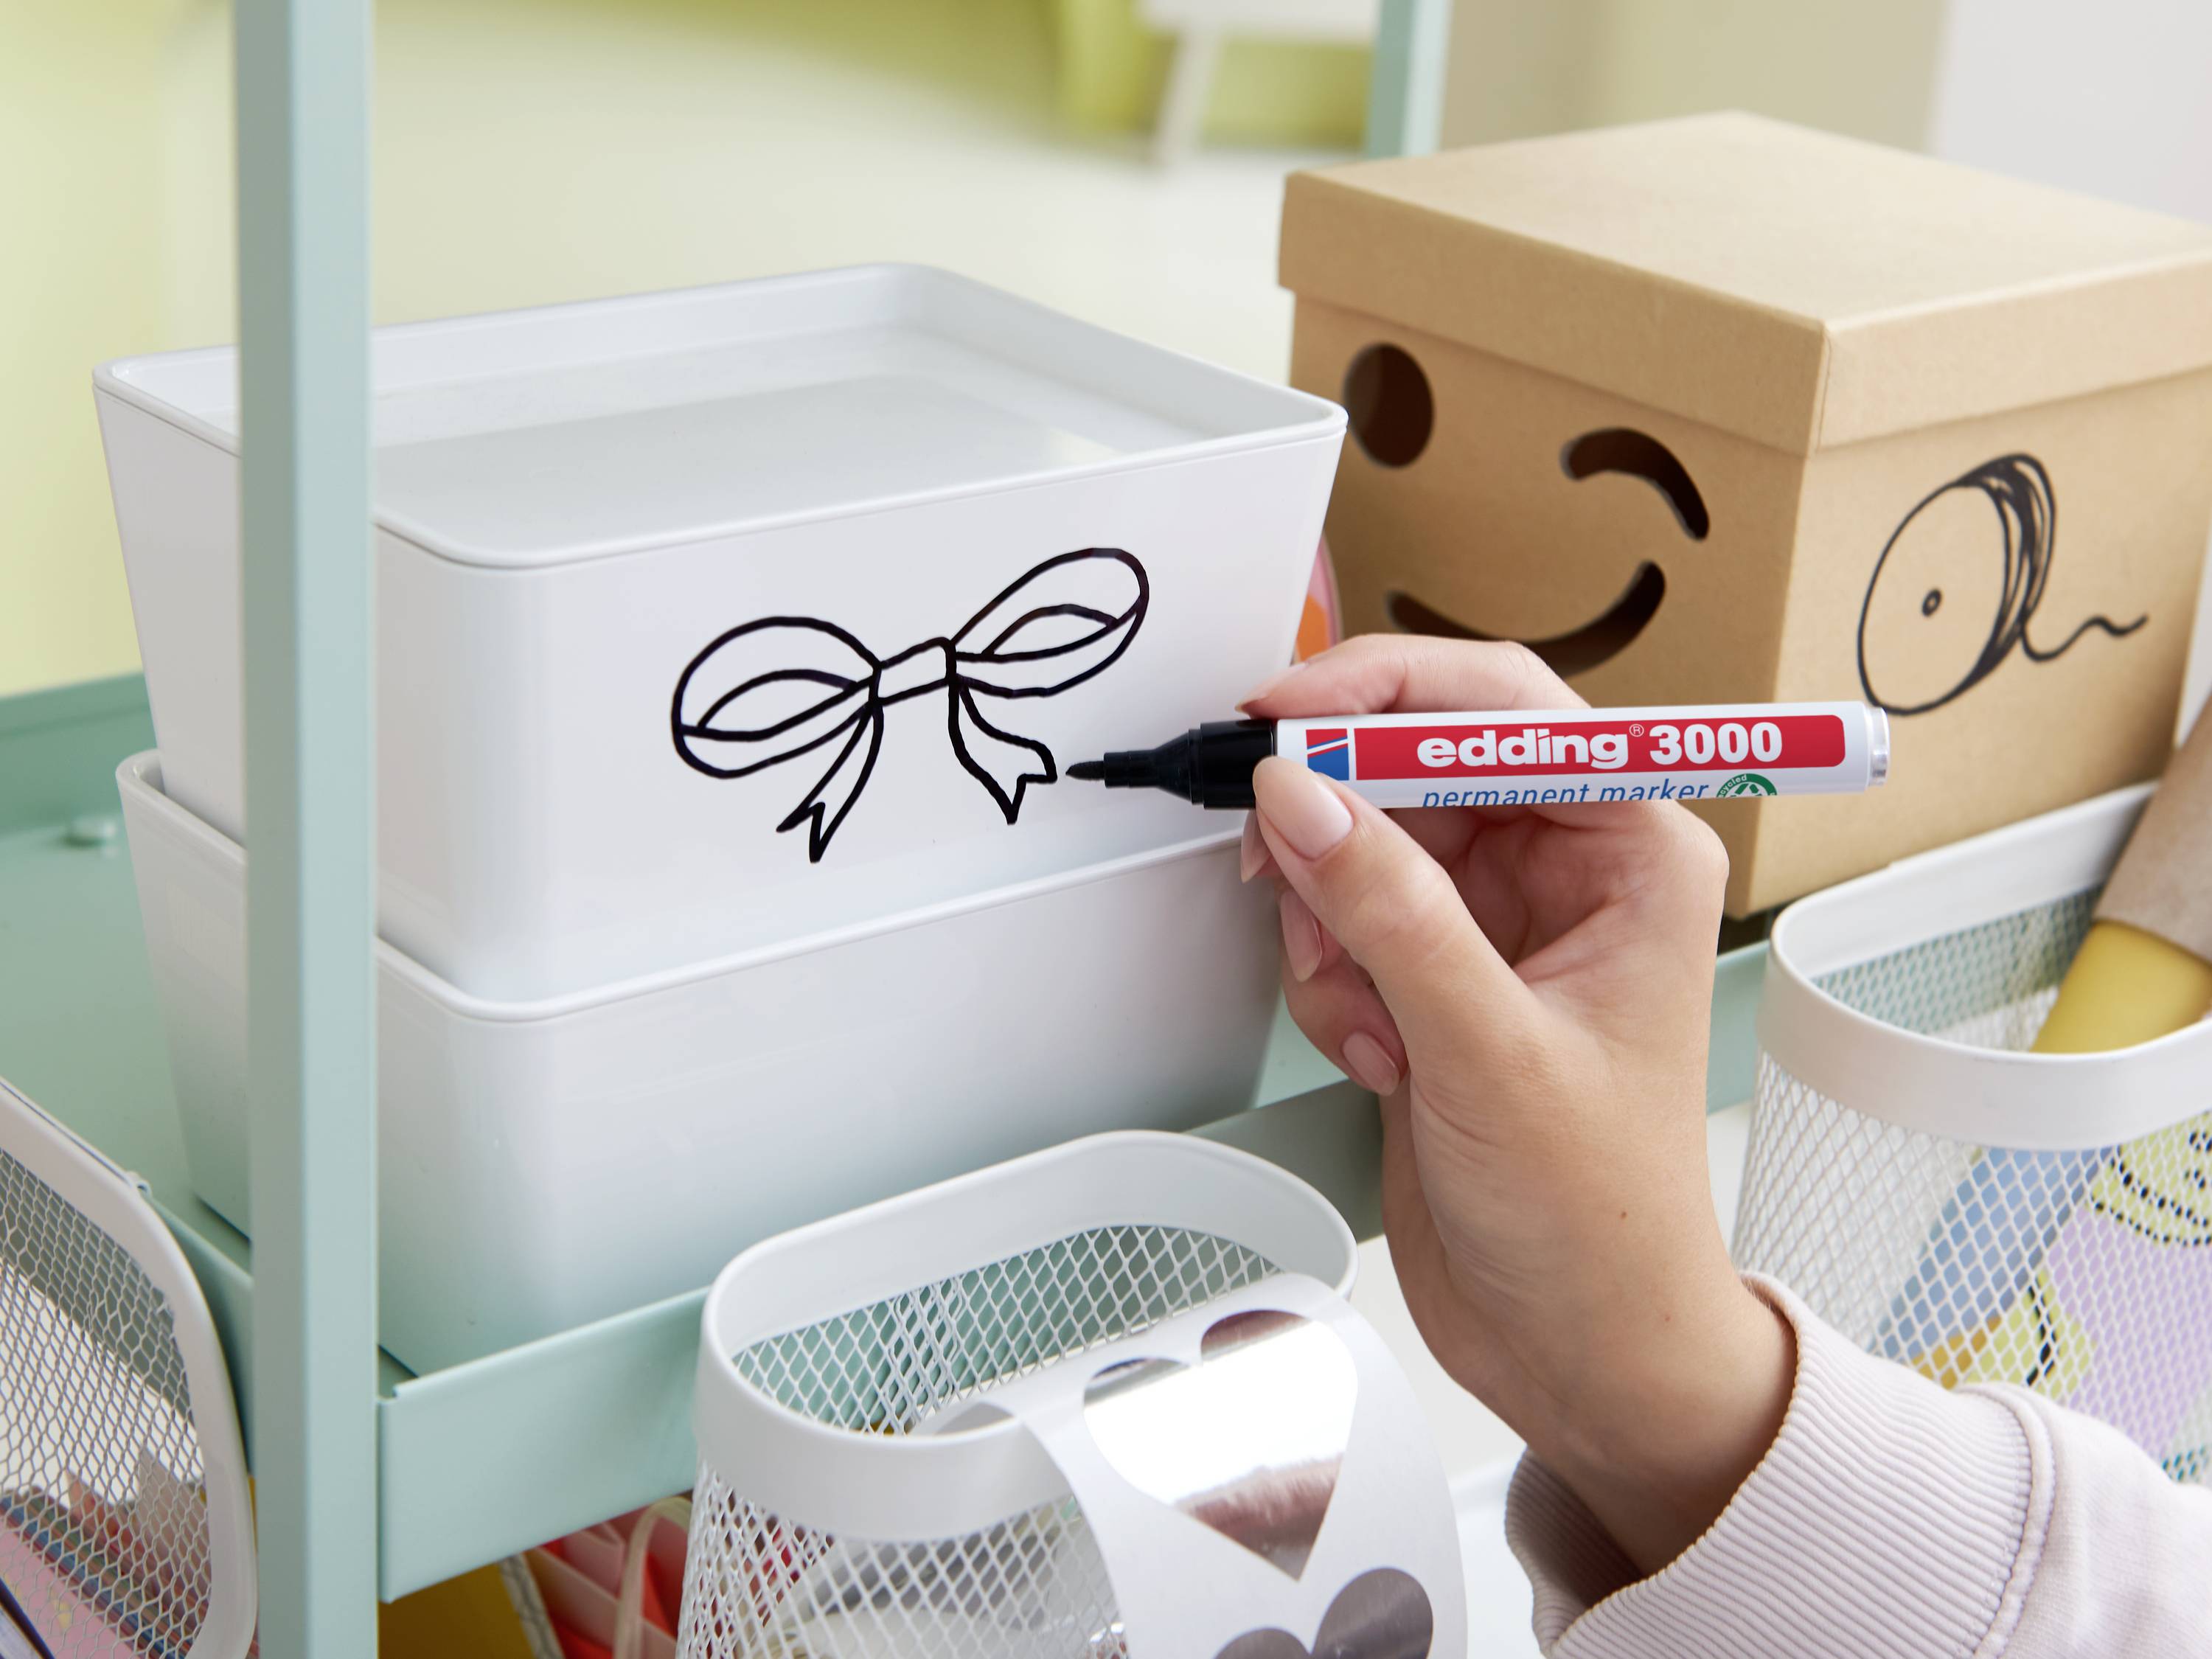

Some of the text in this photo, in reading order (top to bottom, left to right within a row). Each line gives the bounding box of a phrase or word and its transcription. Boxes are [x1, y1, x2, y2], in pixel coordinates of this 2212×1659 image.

[1649, 722, 1783, 765] 3000
[1422, 778, 1709, 808] permanent marker
